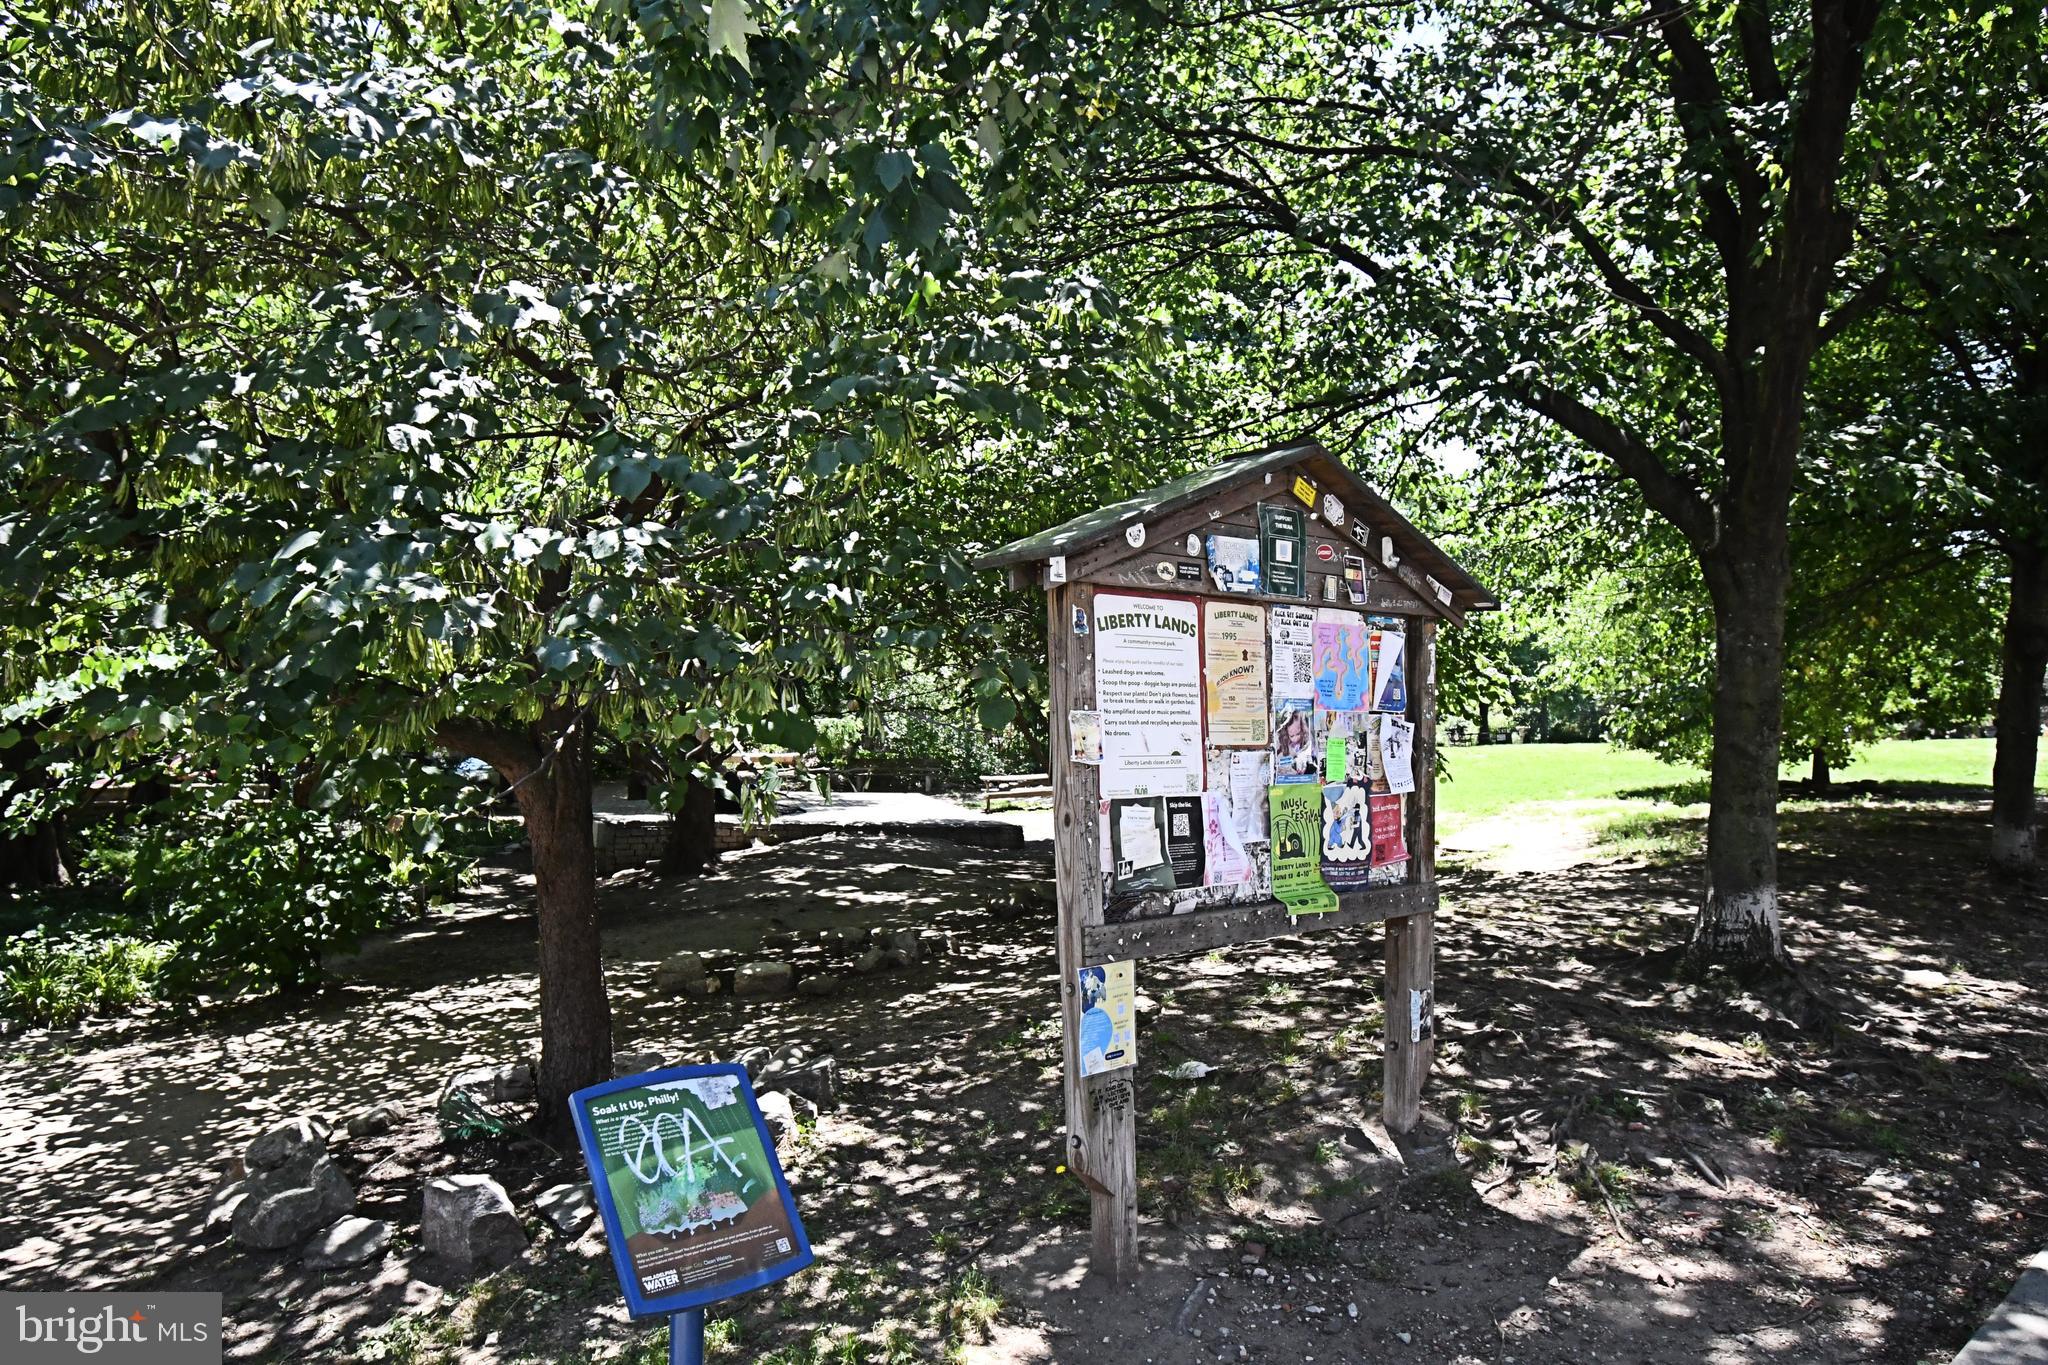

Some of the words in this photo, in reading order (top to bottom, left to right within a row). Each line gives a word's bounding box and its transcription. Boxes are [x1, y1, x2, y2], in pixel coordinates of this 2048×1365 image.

[1214, 611, 1238, 619] LIBERTY
[1239, 612, 1258, 622] LANDS
[1097, 614, 1151, 631] LIBERTY
[1155, 615, 1196, 637] LANDS
[1220, 672, 1229, 681] YOU
[1230, 665, 1254, 676] KNOW?
[1281, 797, 1307, 810] MUSIC
[1291, 809, 1321, 823] FESTIVAL
[592, 1104, 618, 1116] Soak
[619, 1102, 628, 1111] It
[629, 1100, 647, 1110] Up,
[648, 1092, 679, 1105] Philly!
[630, 1110, 649, 1119] garden?
[642, 1268, 677, 1282] PHILADELPHIA
[644, 1274, 679, 1291] WATER
